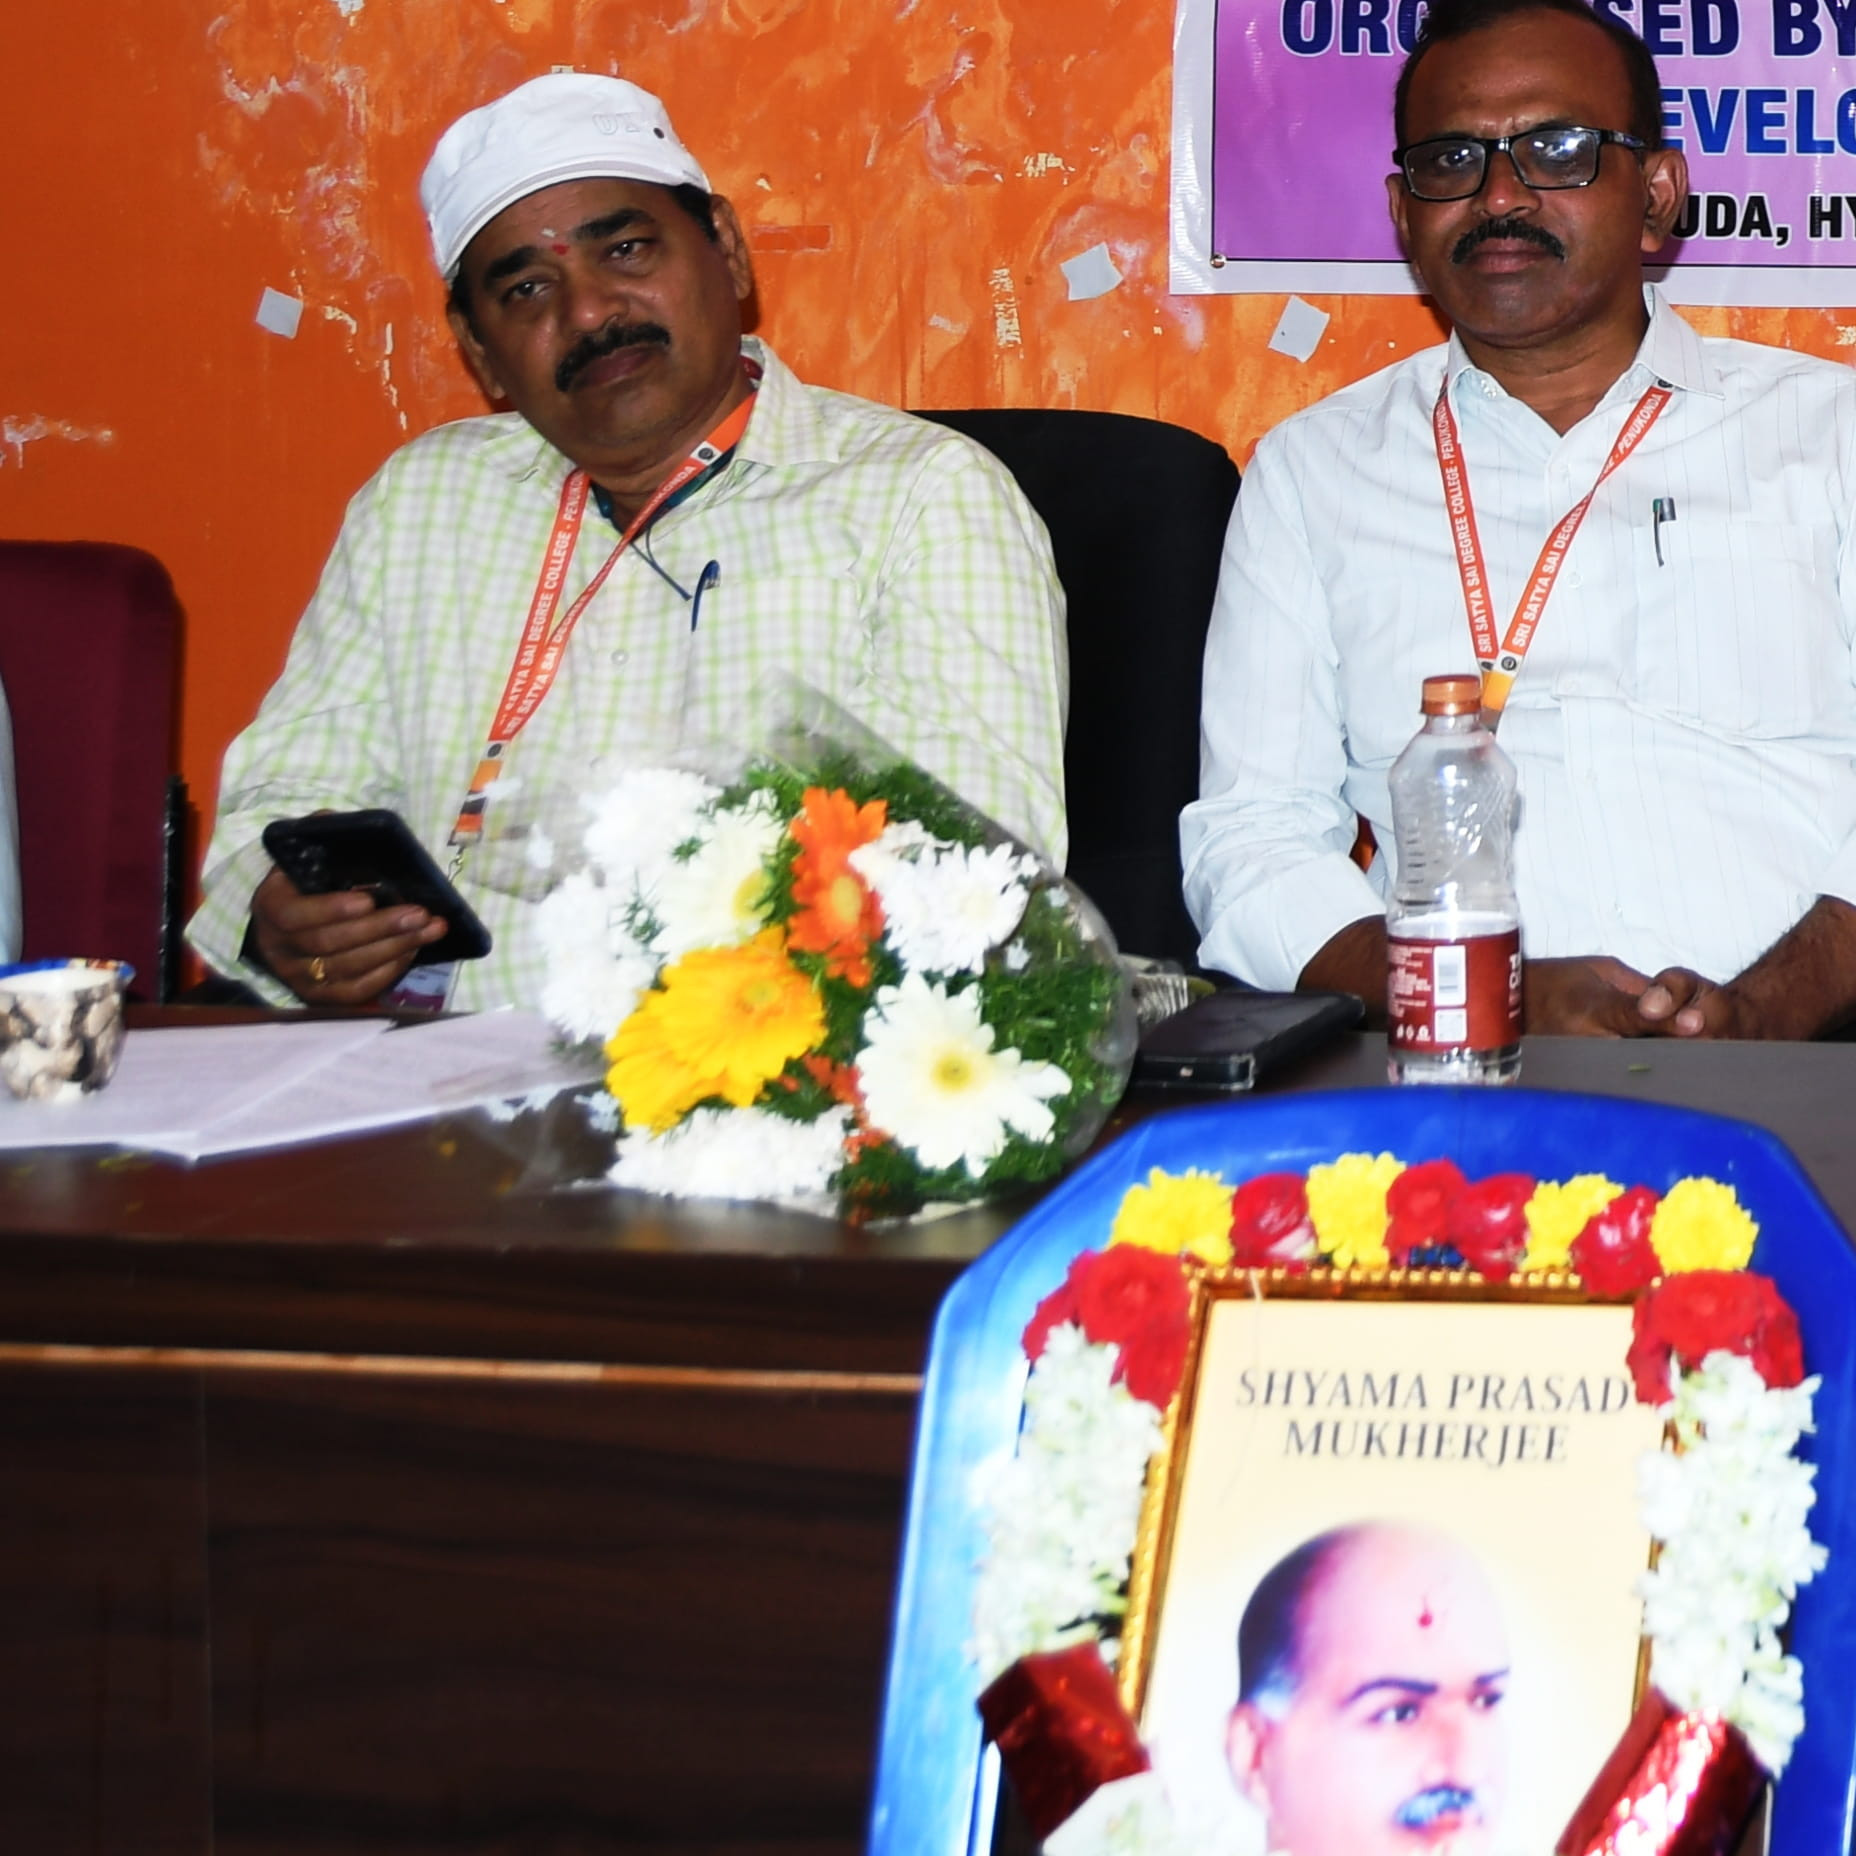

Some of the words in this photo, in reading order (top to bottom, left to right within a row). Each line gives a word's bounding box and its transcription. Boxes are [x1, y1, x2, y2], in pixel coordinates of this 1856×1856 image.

[1617, 393, 1663, 454] PENUKONDA
[1449, 467, 1466, 515] COLLEGE
[1457, 516, 1476, 565] DEGREE
[528, 592, 553, 642] DEGREE
[546, 535, 570, 590] COLLEGE
[1466, 564, 1481, 588] SAI
[1511, 624, 1532, 648] SRI
[1522, 578, 1552, 622] SATYA
[1542, 550, 1562, 578] SAI
[1470, 589, 1490, 632] SATYA
[1478, 631, 1493, 654] SRI
[519, 673, 549, 715] SATYA
[539, 644, 558, 675] SAI
[1237, 1368, 1429, 1410] SHYAMA
[1447, 1373, 1629, 1414] PRASAD
[1283, 1419, 1571, 1469] MUKHERJEE
